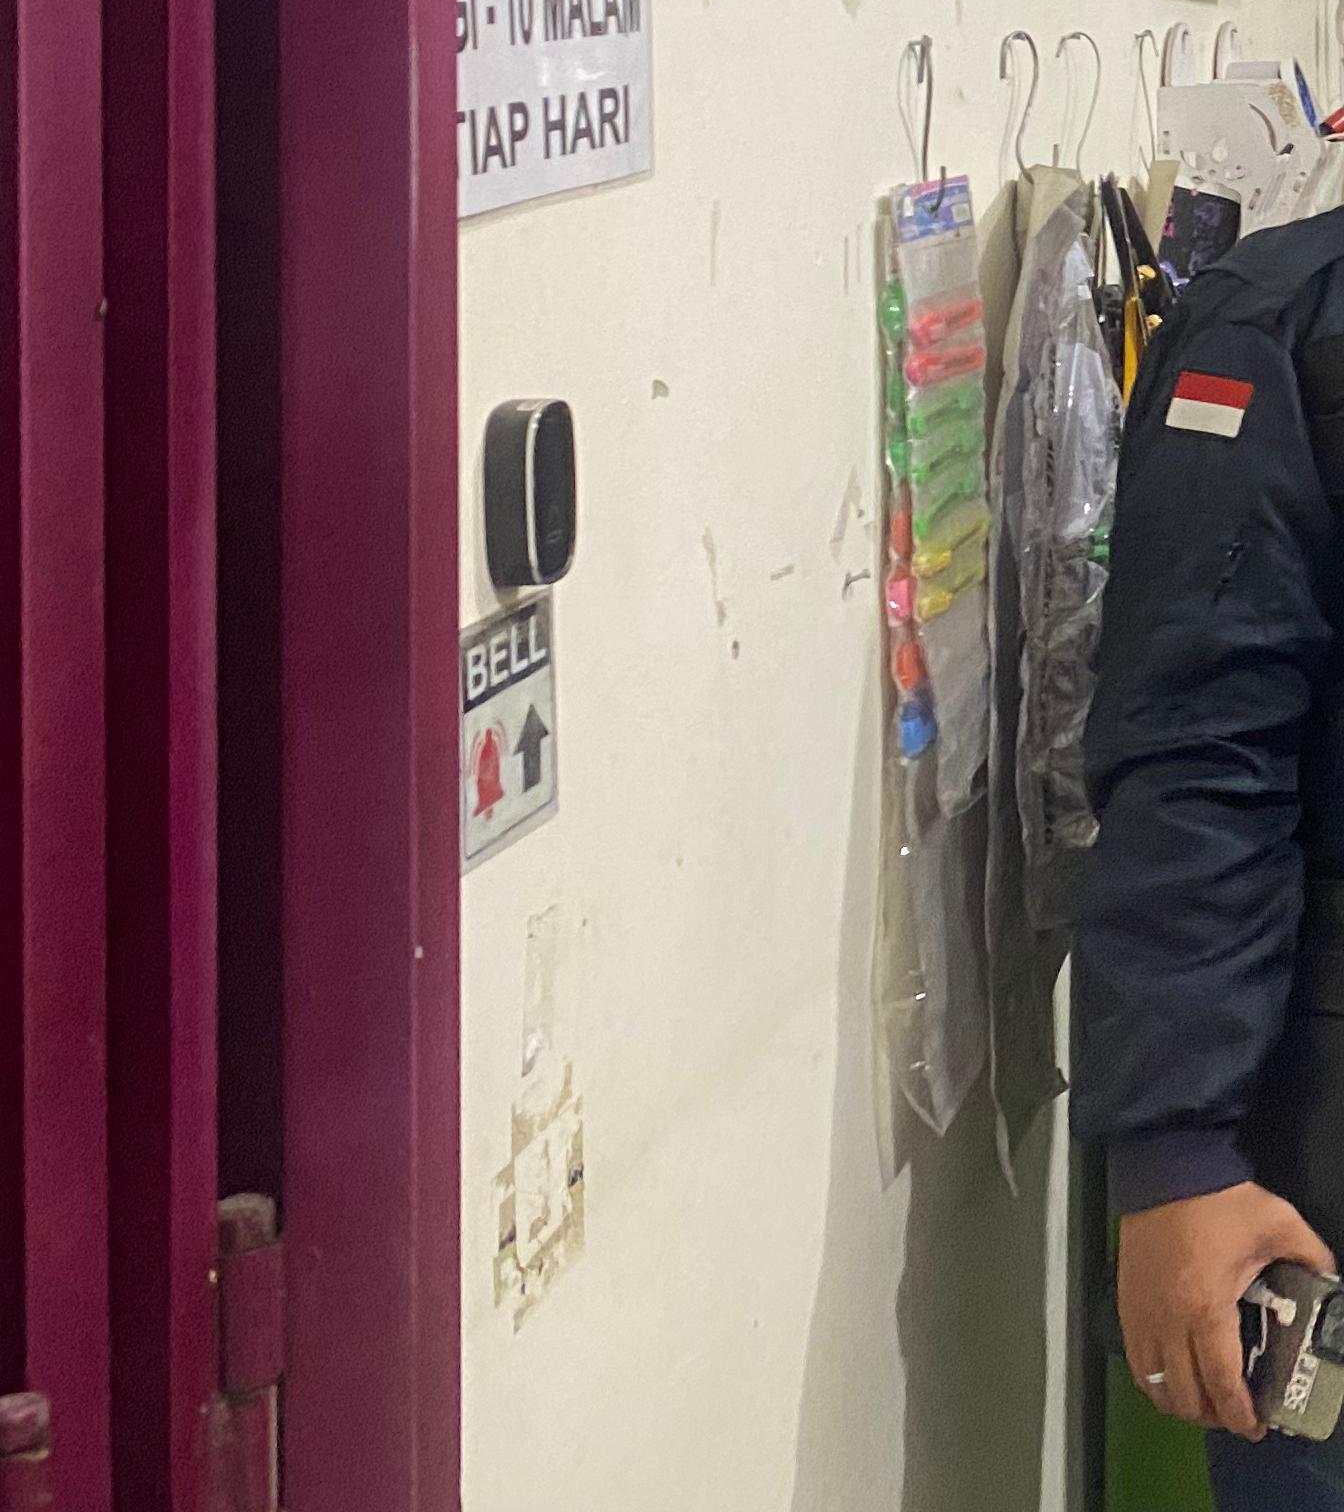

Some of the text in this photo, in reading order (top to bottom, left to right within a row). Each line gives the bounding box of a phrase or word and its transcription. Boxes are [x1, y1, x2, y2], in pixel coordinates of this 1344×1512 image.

[457, 85, 631, 176] IAP HARI
[466, 614, 547, 701] BELL
